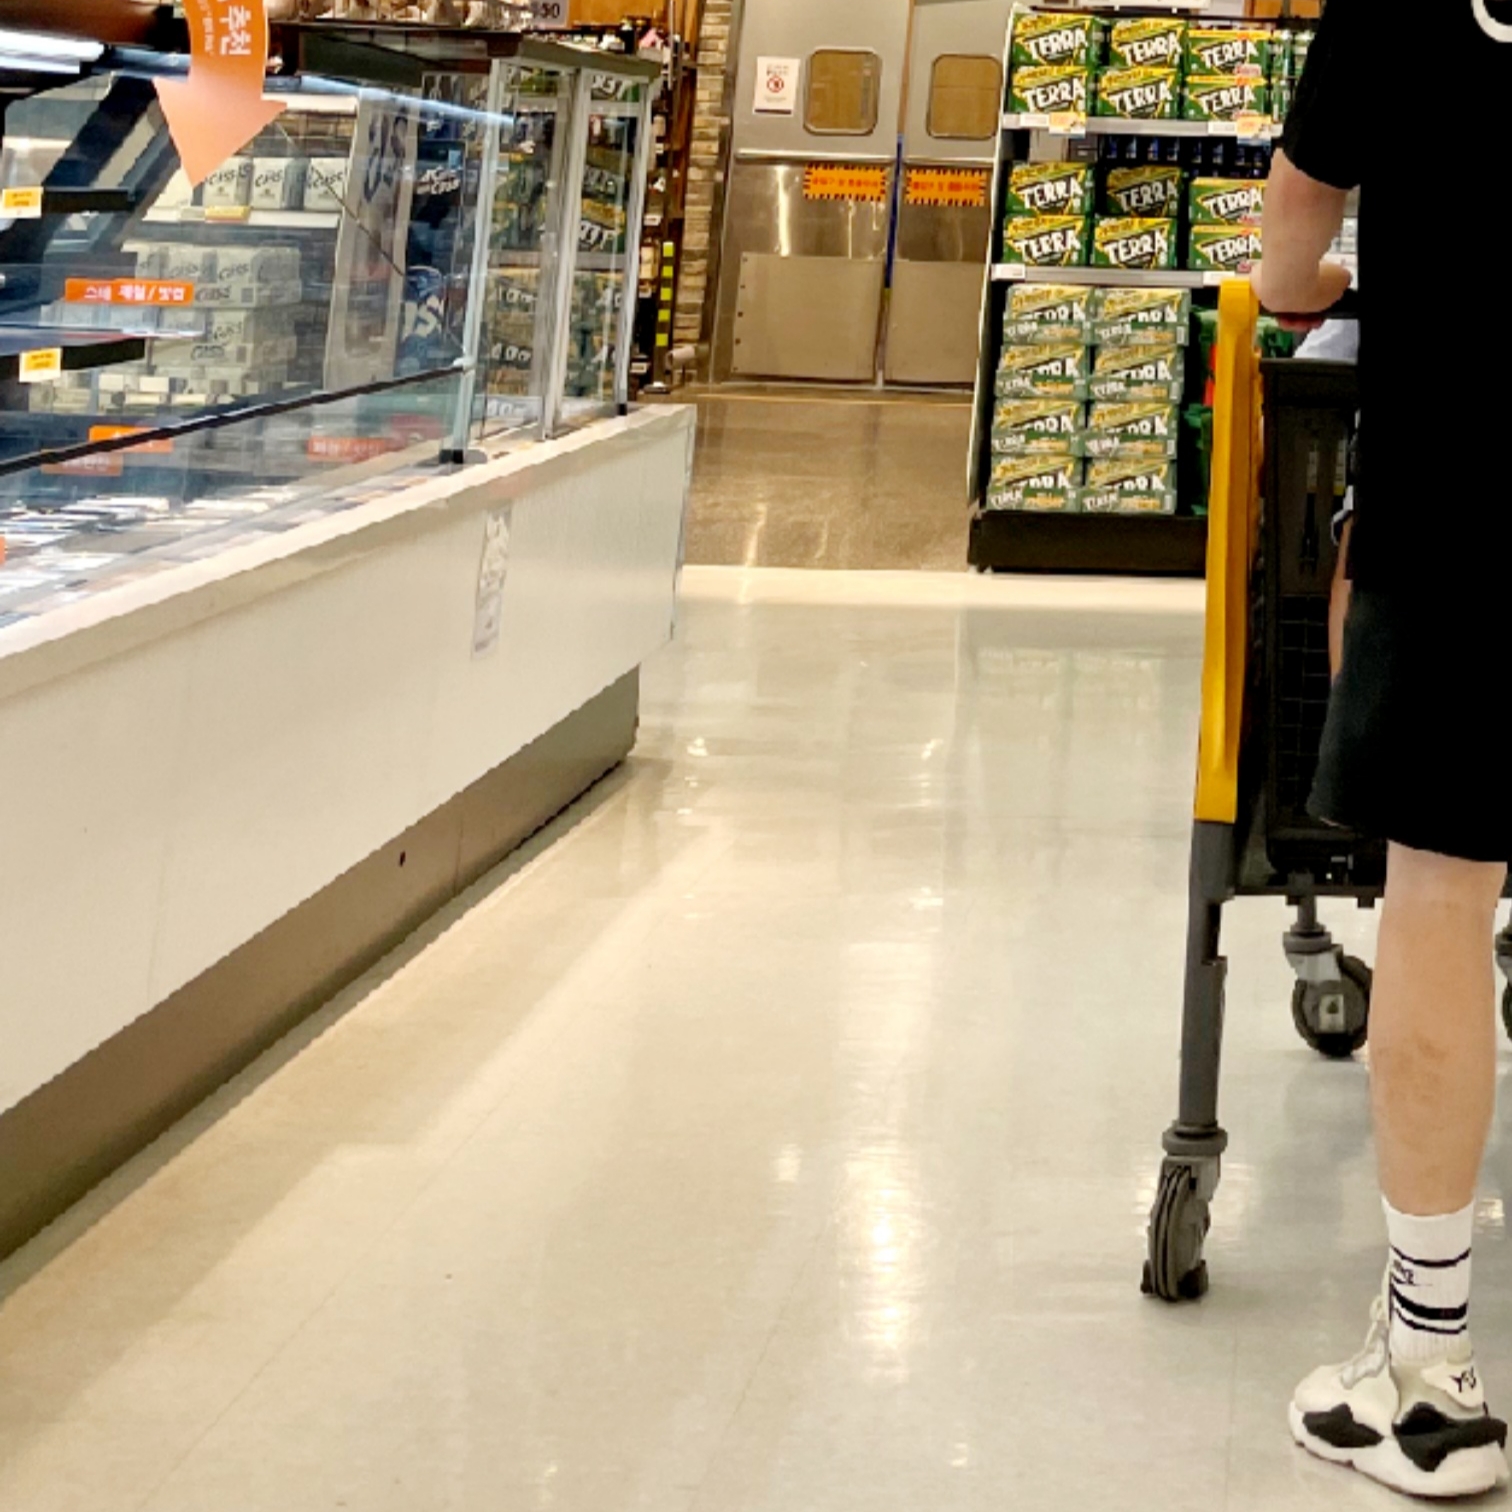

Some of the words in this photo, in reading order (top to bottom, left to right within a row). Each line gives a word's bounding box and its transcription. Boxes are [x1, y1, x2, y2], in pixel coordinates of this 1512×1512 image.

[219, 6, 252, 56] 추천
[1030, 28, 1088, 60] TERRA
[1117, 31, 1182, 67] TERRA
[1202, 39, 1259, 69] TERRA
[1022, 78, 1086, 113] TERRA
[1107, 80, 1173, 117] TERRA
[1199, 85, 1256, 115] TERRA
[1022, 175, 1083, 209] TERRA
[1117, 178, 1180, 213] TERRA
[1019, 228, 1082, 262] TERRA
[1106, 228, 1168, 262] TERRA
